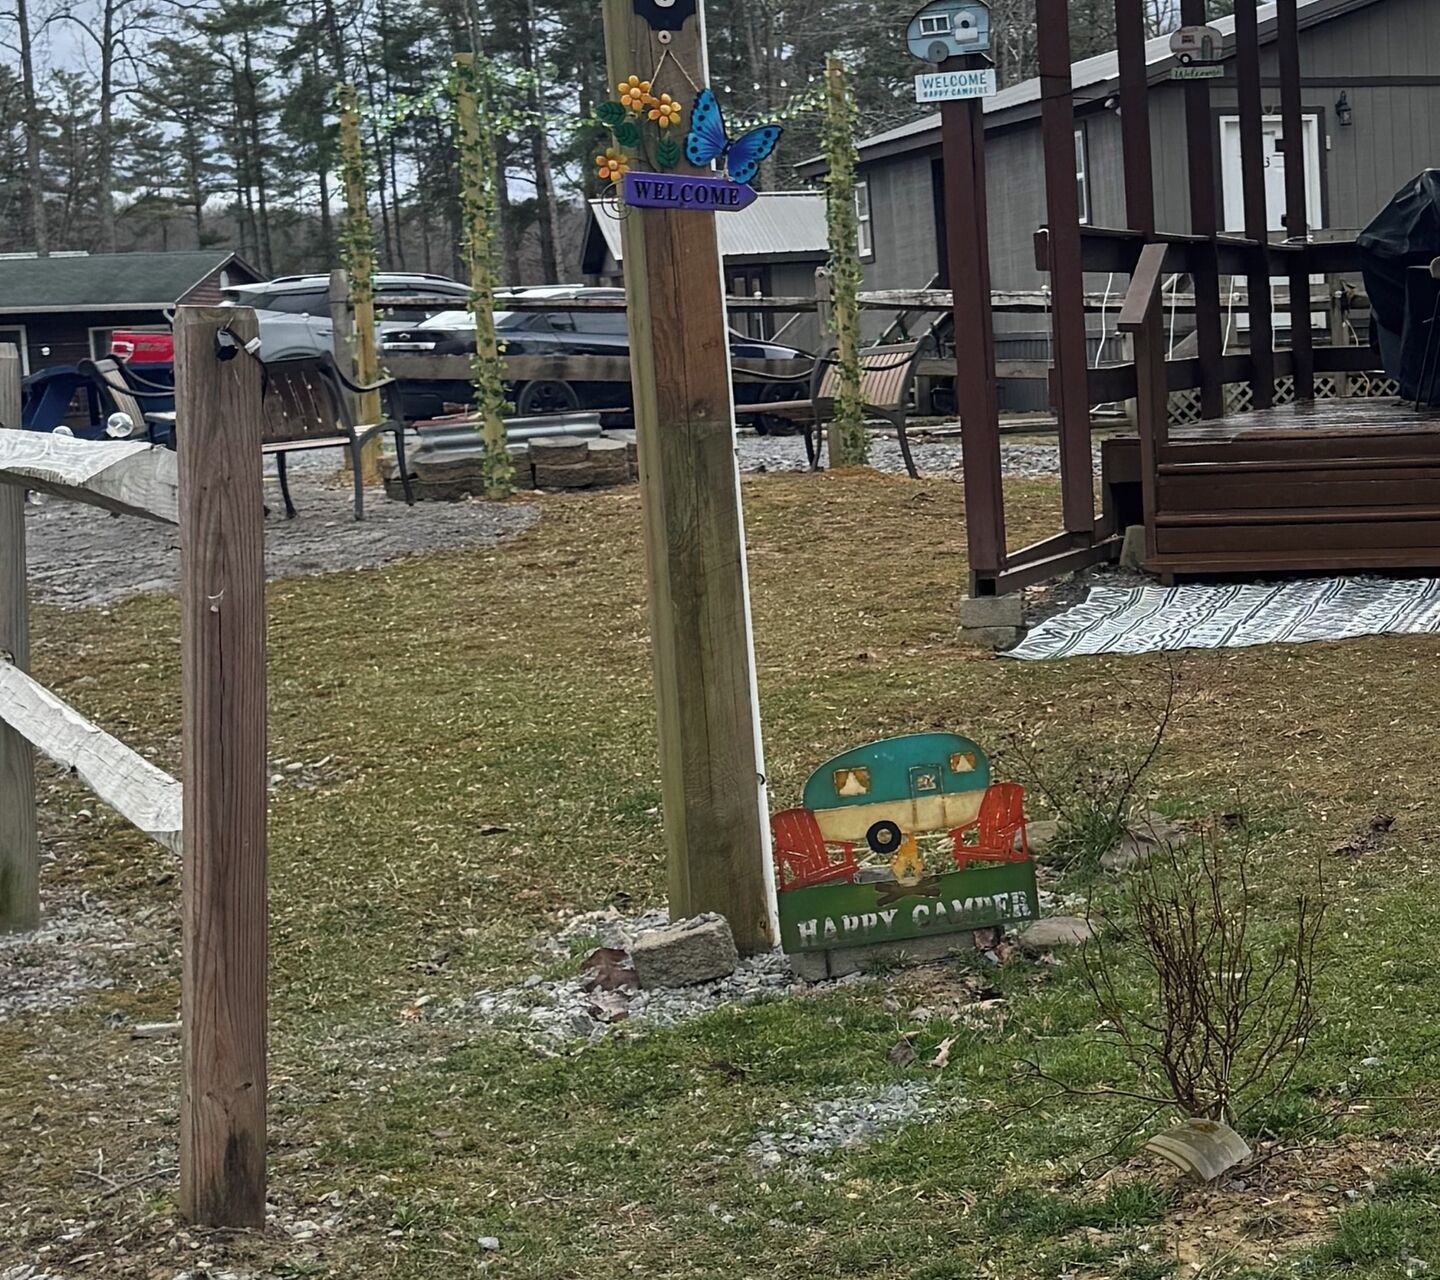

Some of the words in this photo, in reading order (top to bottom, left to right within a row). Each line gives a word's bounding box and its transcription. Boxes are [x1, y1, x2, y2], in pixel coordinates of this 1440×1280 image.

[922, 72, 987, 89] WELCOME
[633, 180, 740, 206] WELCOME
[797, 909, 898, 946] HAPPY
[911, 890, 1032, 930] CAMPER
